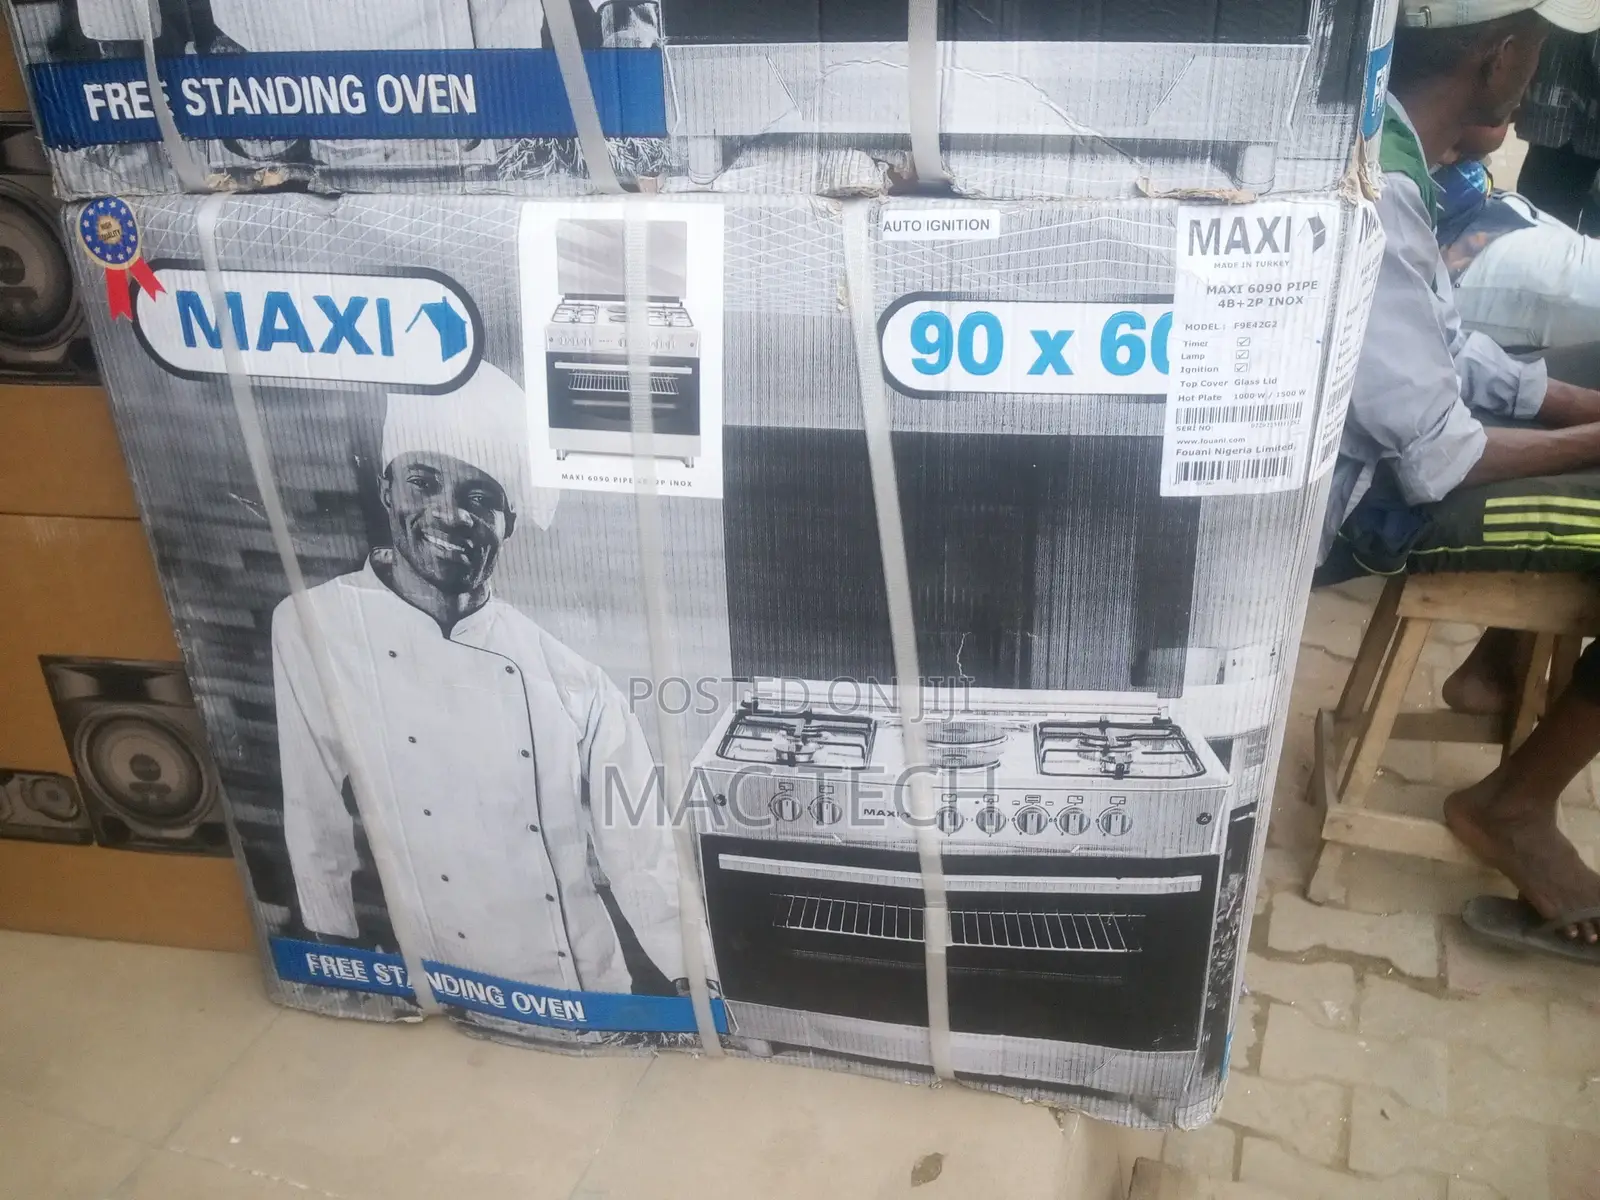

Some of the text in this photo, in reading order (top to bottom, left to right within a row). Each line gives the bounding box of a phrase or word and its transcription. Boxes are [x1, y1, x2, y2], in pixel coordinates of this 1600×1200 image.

[181, 75, 367, 116] STANDING
[377, 73, 477, 115] OVEN
[883, 218, 990, 233] AUTO IGNITION
[1188, 215, 1292, 256] MAXI
[1213, 261, 1239, 269] MADE
[1255, 260, 1290, 268] TURKEY
[1206, 280, 1318, 295] MAXI 6090 PIPE
[1217, 295, 1304, 309] 4B+2P INOX
[176, 290, 395, 357] MAXI
[1233, 320, 1278, 330] F9E42G2
[910, 310, 1004, 376] 90
[1026, 329, 1075, 376] x
[1183, 340, 1208, 348] Timer
[1181, 353, 1205, 361] Lamp
[1180, 366, 1219, 374] Ignition
[1180, 380, 1198, 388] Top
[1234, 378, 1260, 386] Glass
[1263, 377, 1278, 385] Lid
[1178, 394, 1195, 402] Hot
[1233, 392, 1255, 400] 1000
[1176, 447, 1211, 456] Fouani
[1214, 445, 1252, 457] Nigeria
[561, 473, 584, 481] MAXI
[588, 475, 610, 483] 6090
[670, 480, 693, 488] INOX
[863, 808, 900, 818] MAXI
[305, 952, 370, 984] FREE
[512, 991, 587, 1023] OVEN
